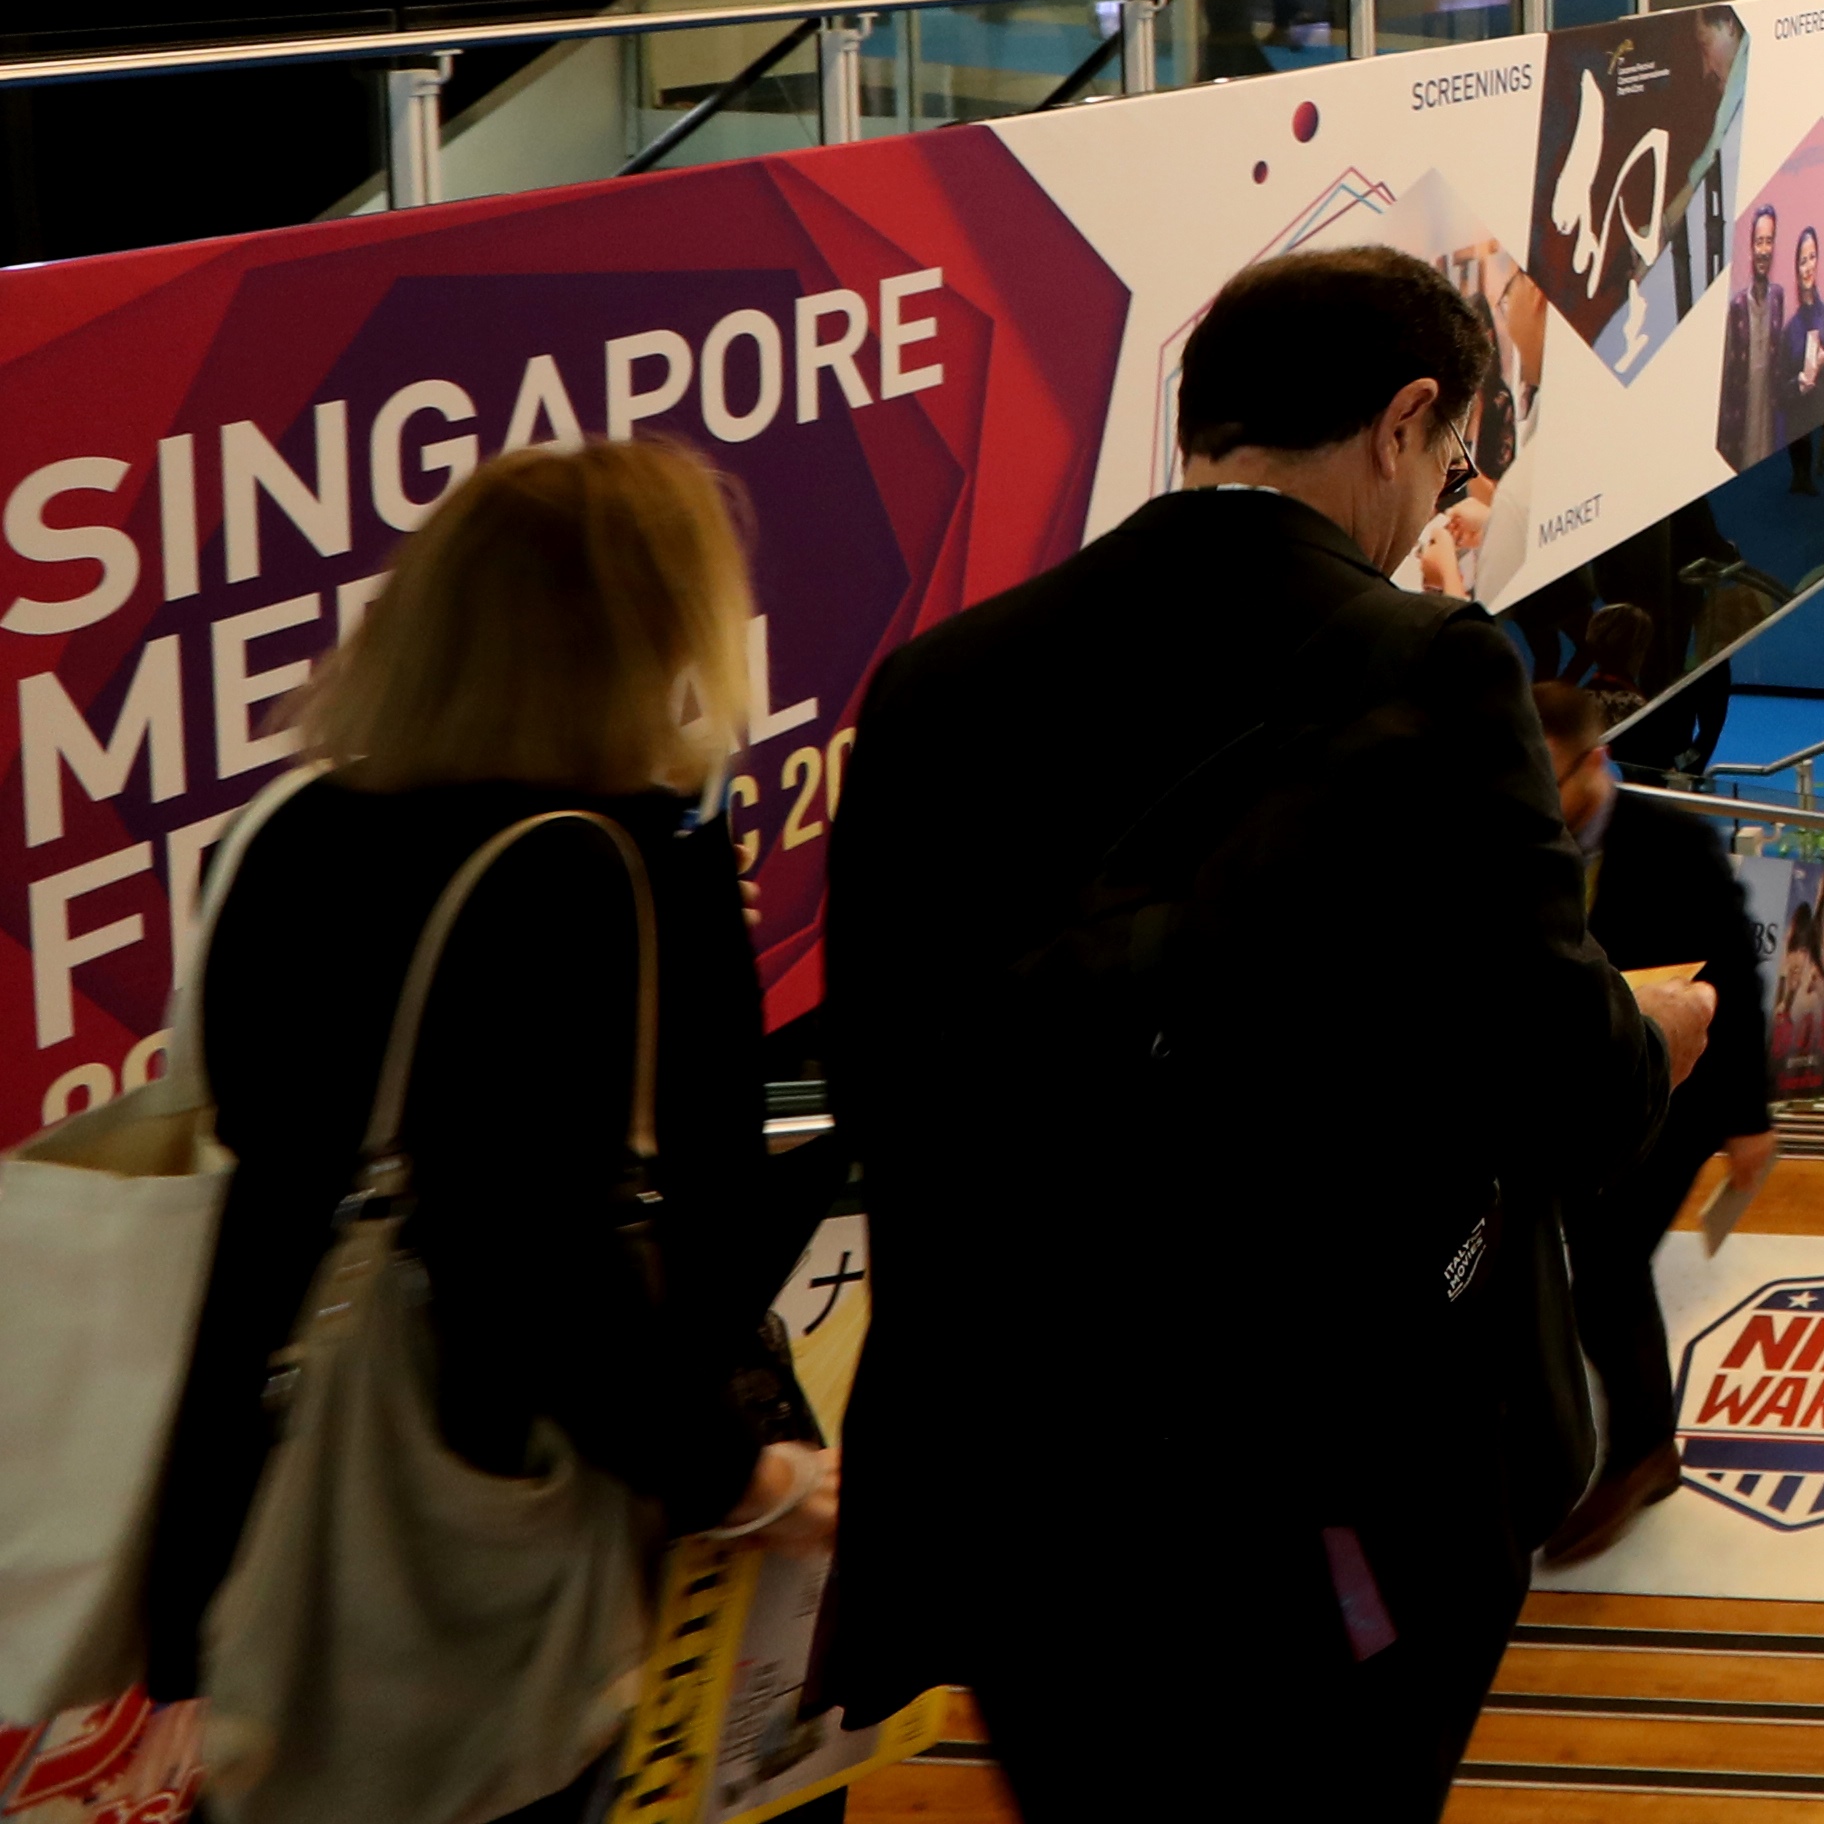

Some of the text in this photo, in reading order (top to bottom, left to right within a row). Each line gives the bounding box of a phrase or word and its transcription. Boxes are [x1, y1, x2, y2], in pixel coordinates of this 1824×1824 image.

[1412, 64, 1533, 111] SCREENINGS
[0, 266, 945, 636] SINGAPORE
[1538, 493, 1603, 548] MARKET
